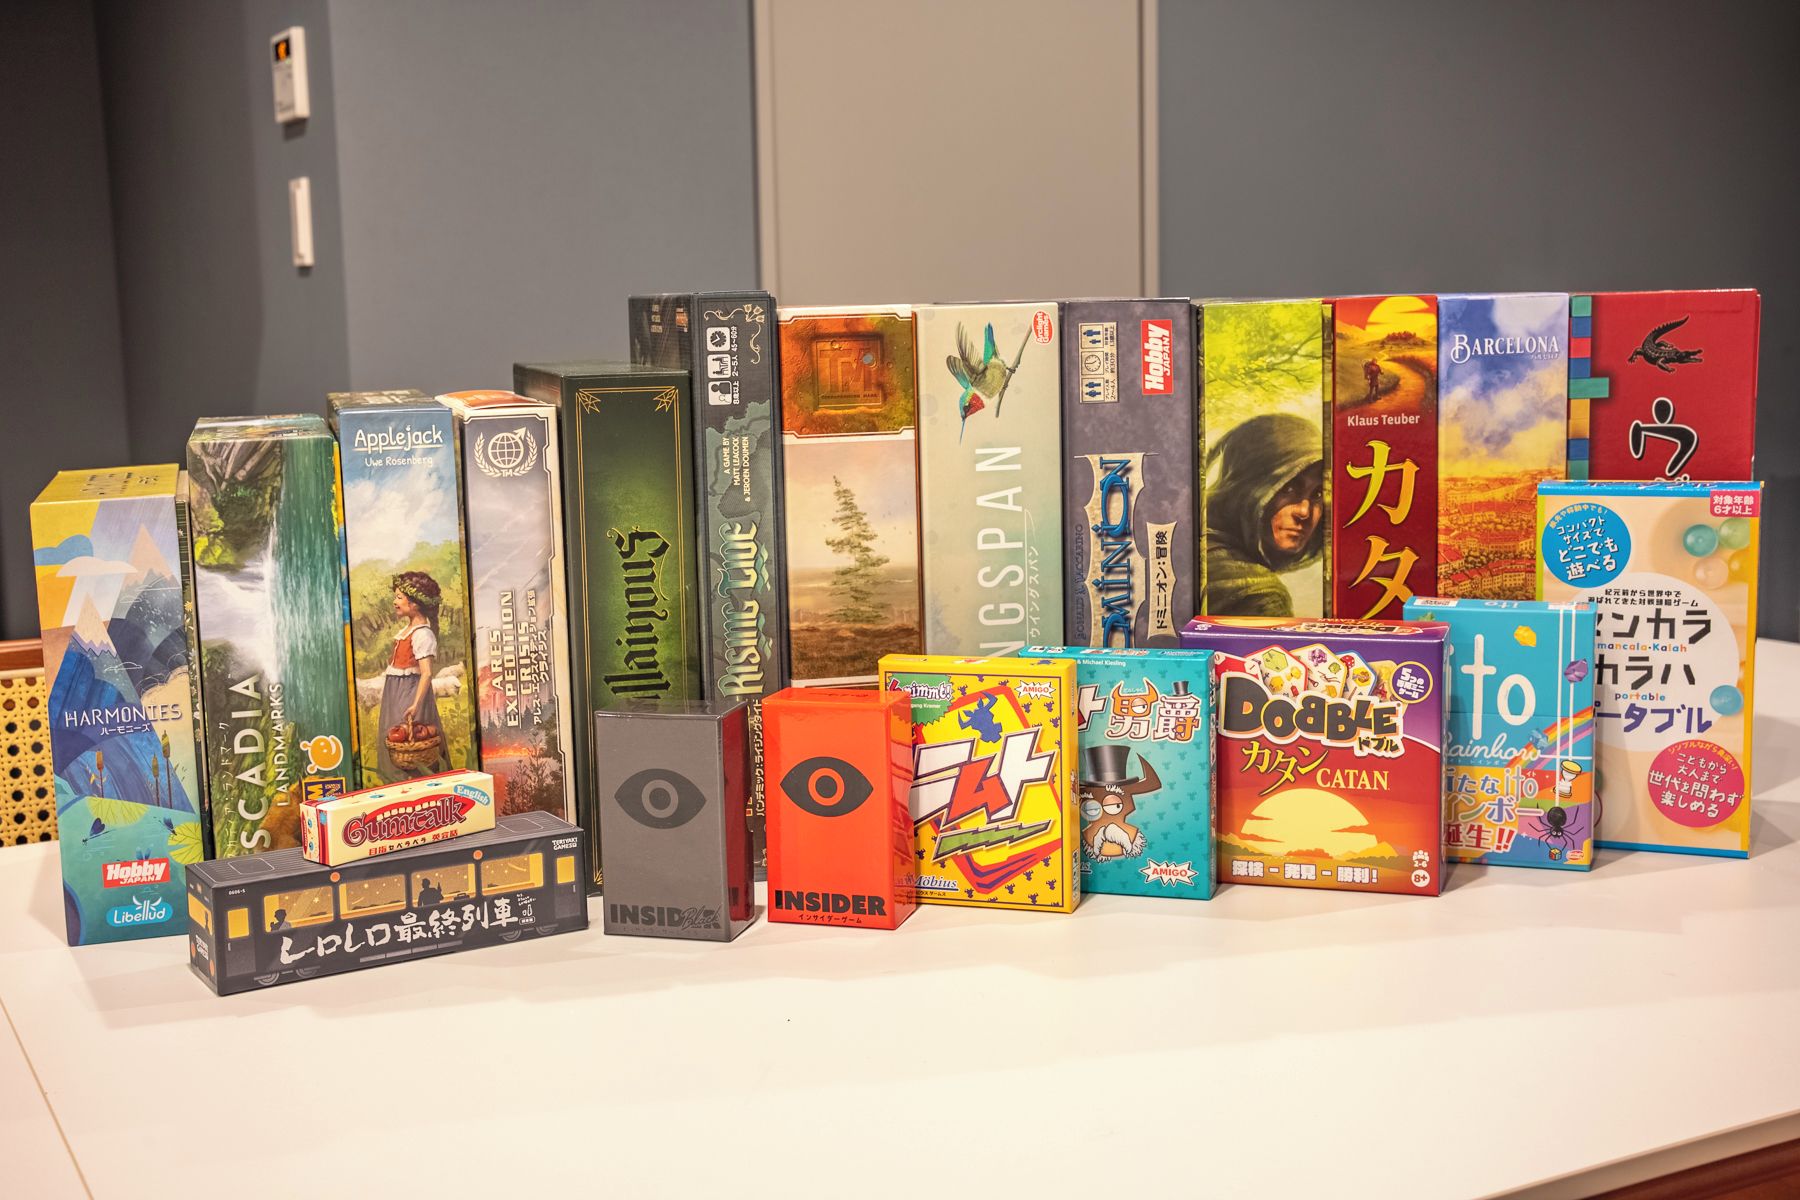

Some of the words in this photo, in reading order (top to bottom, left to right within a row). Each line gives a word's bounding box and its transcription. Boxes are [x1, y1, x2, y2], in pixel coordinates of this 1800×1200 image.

[1144, 323, 1169, 391] Hobby
[1161, 336, 1171, 375] JAPAN
[1450, 334, 1559, 364] BARCELONA
[1347, 414, 1379, 427] Klaus
[1381, 413, 1420, 426] Teuber
[354, 424, 444, 454] Applejack
[722, 437, 729, 446] BY
[732, 437, 740, 465] LEACOCK
[742, 436, 750, 466] DOUMEN
[365, 457, 384, 467] Uwe
[385, 455, 433, 468] Rosenberg
[1713, 495, 1754, 505] 対象年齢
[1713, 505, 1752, 515] 6才以上
[1557, 516, 1605, 535] コンパクト
[1563, 528, 1605, 544] サイズで
[974, 446, 1026, 658] NGSPAN
[1092, 456, 1133, 649] OMINION
[1559, 537, 1618, 563] どこでも
[1566, 554, 1616, 580] 遊べる
[603, 526, 671, 699] llainous
[490, 630, 504, 690] ARES
[500, 591, 519, 727] EXPEDITION
[517, 622, 533, 695] CRISIS
[1105, 660, 1126, 668] Kiesling
[1595, 654, 1696, 690] カラハ
[1022, 686, 1050, 694] AMIGO
[1615, 692, 1666, 702] portable
[65, 704, 182, 728] HARMONIES
[1223, 676, 1398, 741] DOBBLE
[1597, 703, 1713, 734] ータブル
[100, 723, 150, 735] ハーモニーズ
[269, 684, 290, 806] LANDMARKS
[1357, 738, 1398, 751] ドブル
[1447, 732, 1541, 761] ainbow
[229, 674, 271, 849] SCADIA
[1241, 740, 1329, 795] カタン
[1678, 765, 1722, 784] 大人まで
[1316, 768, 1389, 790] CATAN
[1649, 770, 1744, 806] 世代を問わず
[456, 784, 489, 805] English
[1661, 790, 1719, 817] 楽しめる
[342, 797, 467, 847] Gumtalk
[552, 837, 578, 846] TERIYAKI
[106, 861, 167, 881] Hobby
[1151, 868, 1188, 878] AMIGO
[1414, 860, 1428, 868] 2-6
[119, 875, 157, 885] JAPAN
[1414, 874, 1428, 883] 8+
[113, 899, 166, 925] Libellud
[775, 890, 887, 916] INSIDER
[610, 904, 722, 930] INSID
[681, 903, 723, 930] Black
[798, 913, 863, 924] インサイダーゲーム
